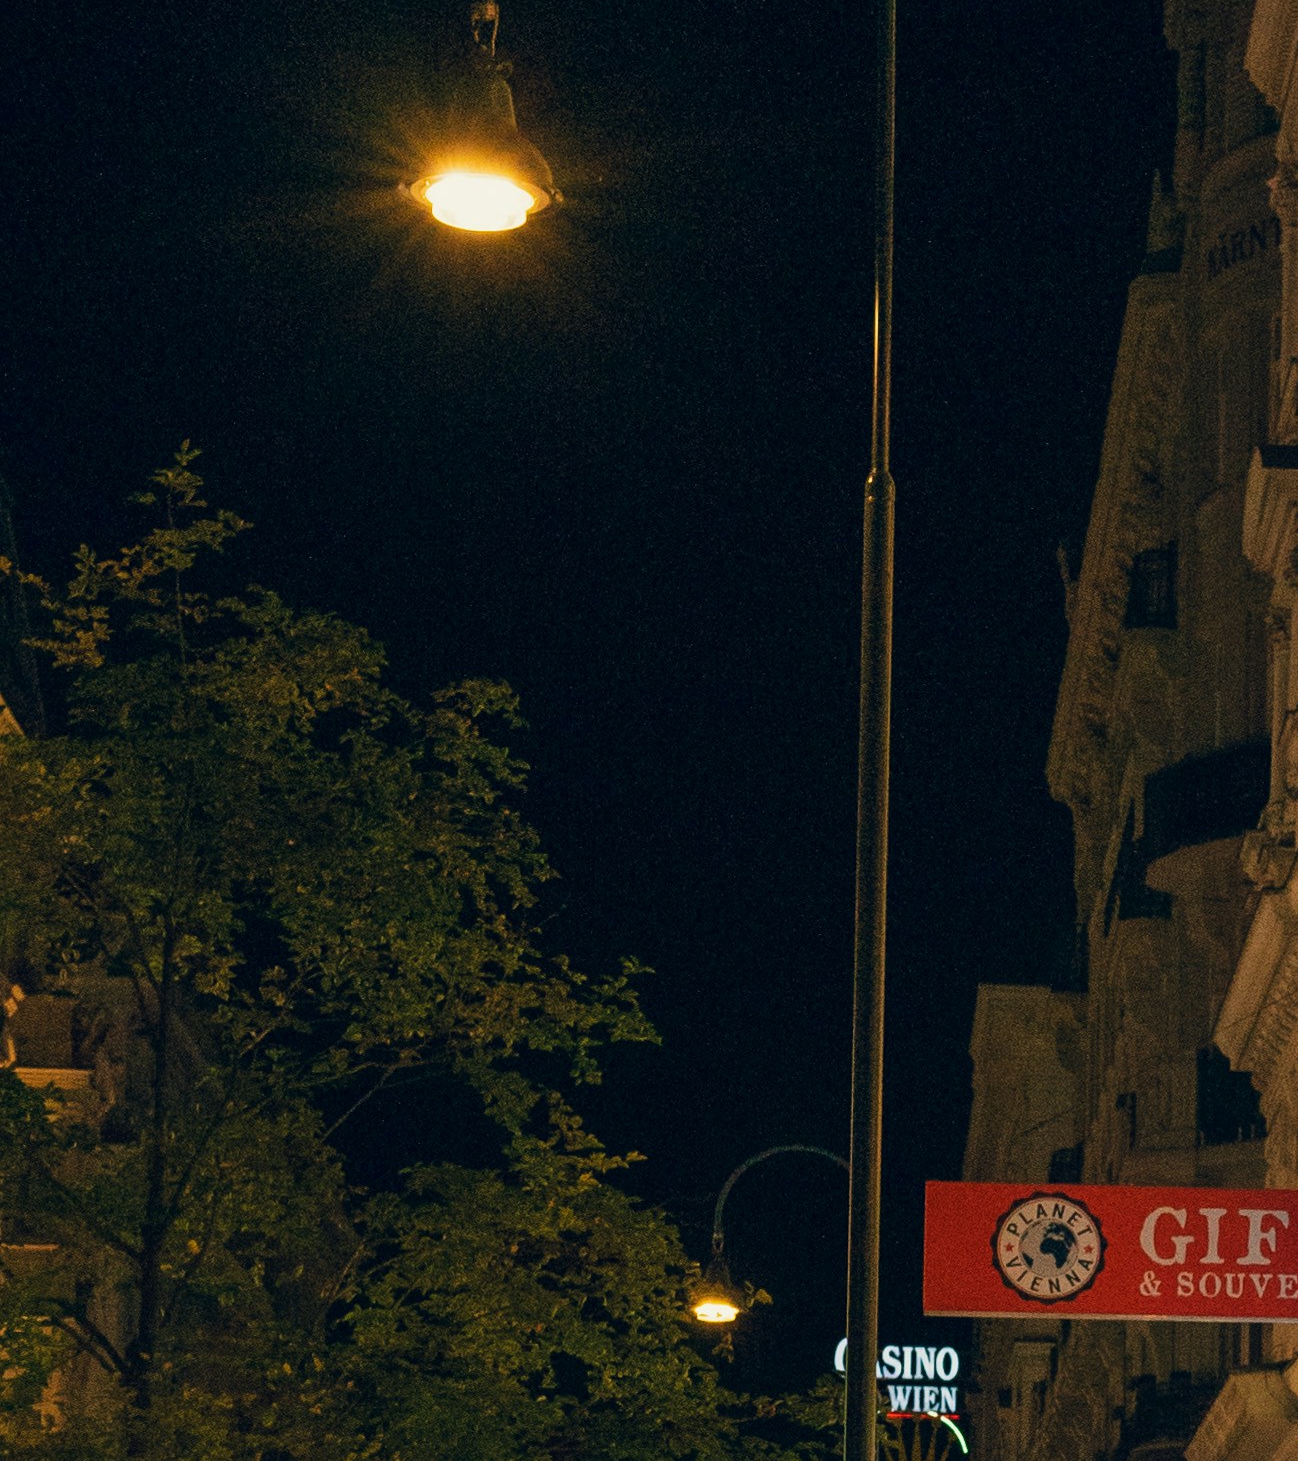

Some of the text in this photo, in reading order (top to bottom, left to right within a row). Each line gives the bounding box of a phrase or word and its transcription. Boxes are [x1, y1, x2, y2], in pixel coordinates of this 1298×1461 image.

[1006, 1203, 1093, 1237] PLANET
[1006, 1256, 1093, 1293] VIENNA
[1139, 1271, 1162, 1298] &
[834, 1337, 960, 1381] CSINO
[888, 1385, 957, 1413] WIEN
